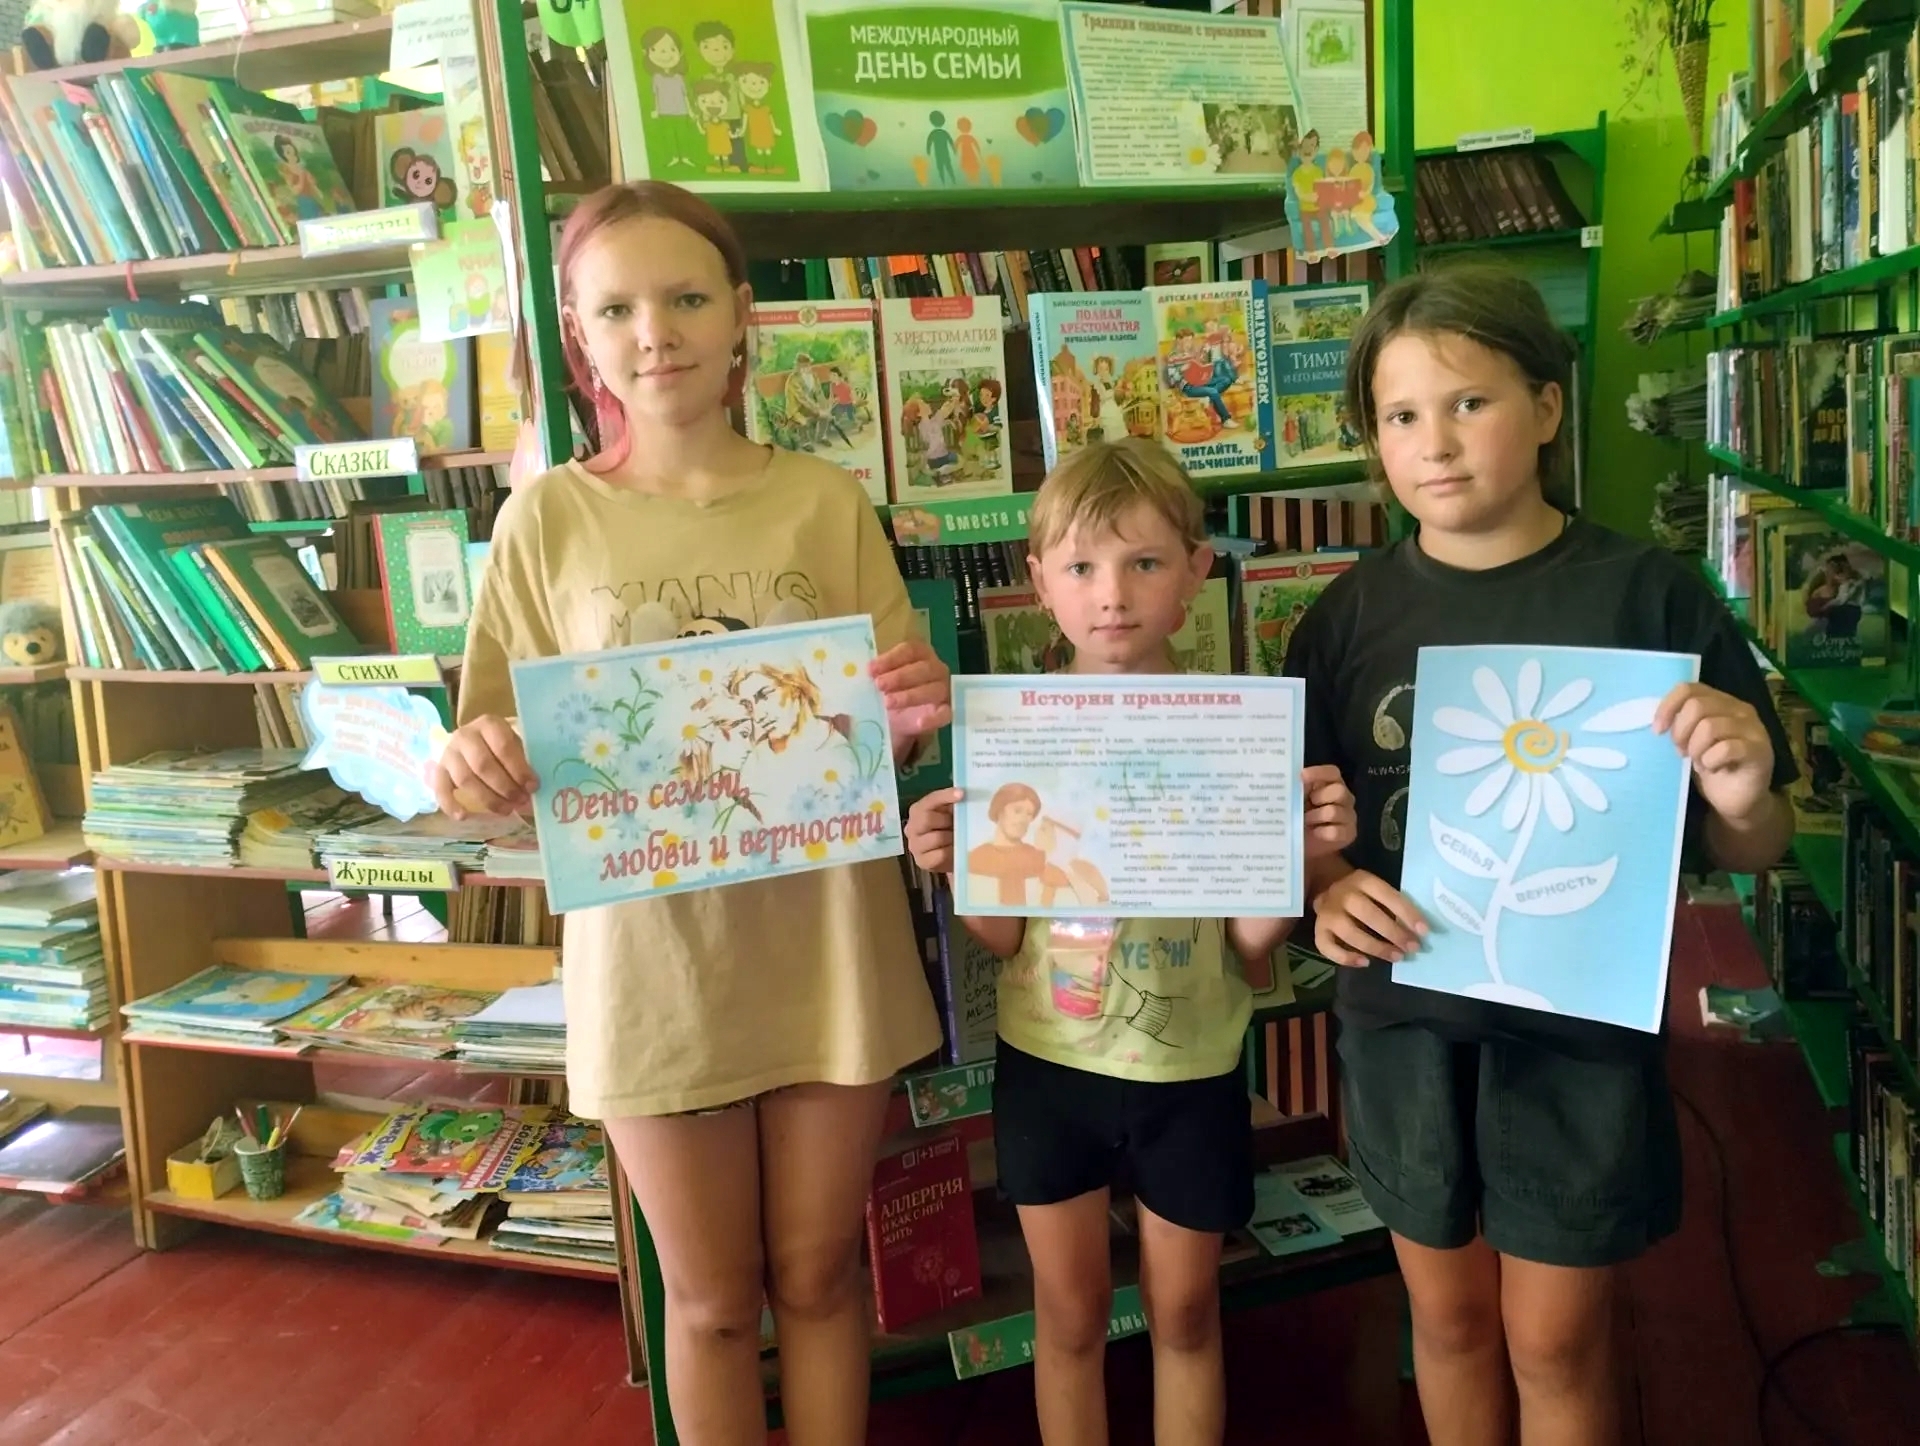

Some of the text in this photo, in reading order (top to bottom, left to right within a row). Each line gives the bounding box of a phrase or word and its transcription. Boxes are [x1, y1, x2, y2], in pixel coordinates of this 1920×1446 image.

[850, 24, 1020, 48] МЕЖДУНАРОДНЫЙ
[855, 51, 1022, 83] ДЕНЬ СЕМЬИ
[1158, 291, 1249, 303] ДЕТСКАЯ КЛАССИКА
[1060, 320, 1140, 334] ХРЕСТОМАТИЯ
[1076, 308, 1122, 320] ПОЛНАЯ
[894, 328, 998, 345] ХРЕСТОМАТИЯ
[1254, 298, 1270, 404] ХРЕСТОМАТИЯ
[1181, 441, 1243, 458] ЧИТАЙТЕ,
[1021, 690, 1243, 709] История праздника
[552, 771, 751, 824] День семьи,
[600, 807, 886, 882] любви и верности
[1439, 833, 1495, 872] СЕМЬЯ
[336, 861, 435, 885] Журналы
[1515, 874, 1598, 903] ВЕРНОСТЬ
[1437, 893, 1482, 931] ЛЮБОВЬ
[881, 1176, 964, 1221] АЛЛЕРГИЯ
[882, 1198, 945, 1234] И КАК С НЕЙ
[883, 1226, 914, 1247] ЖИТЬ
